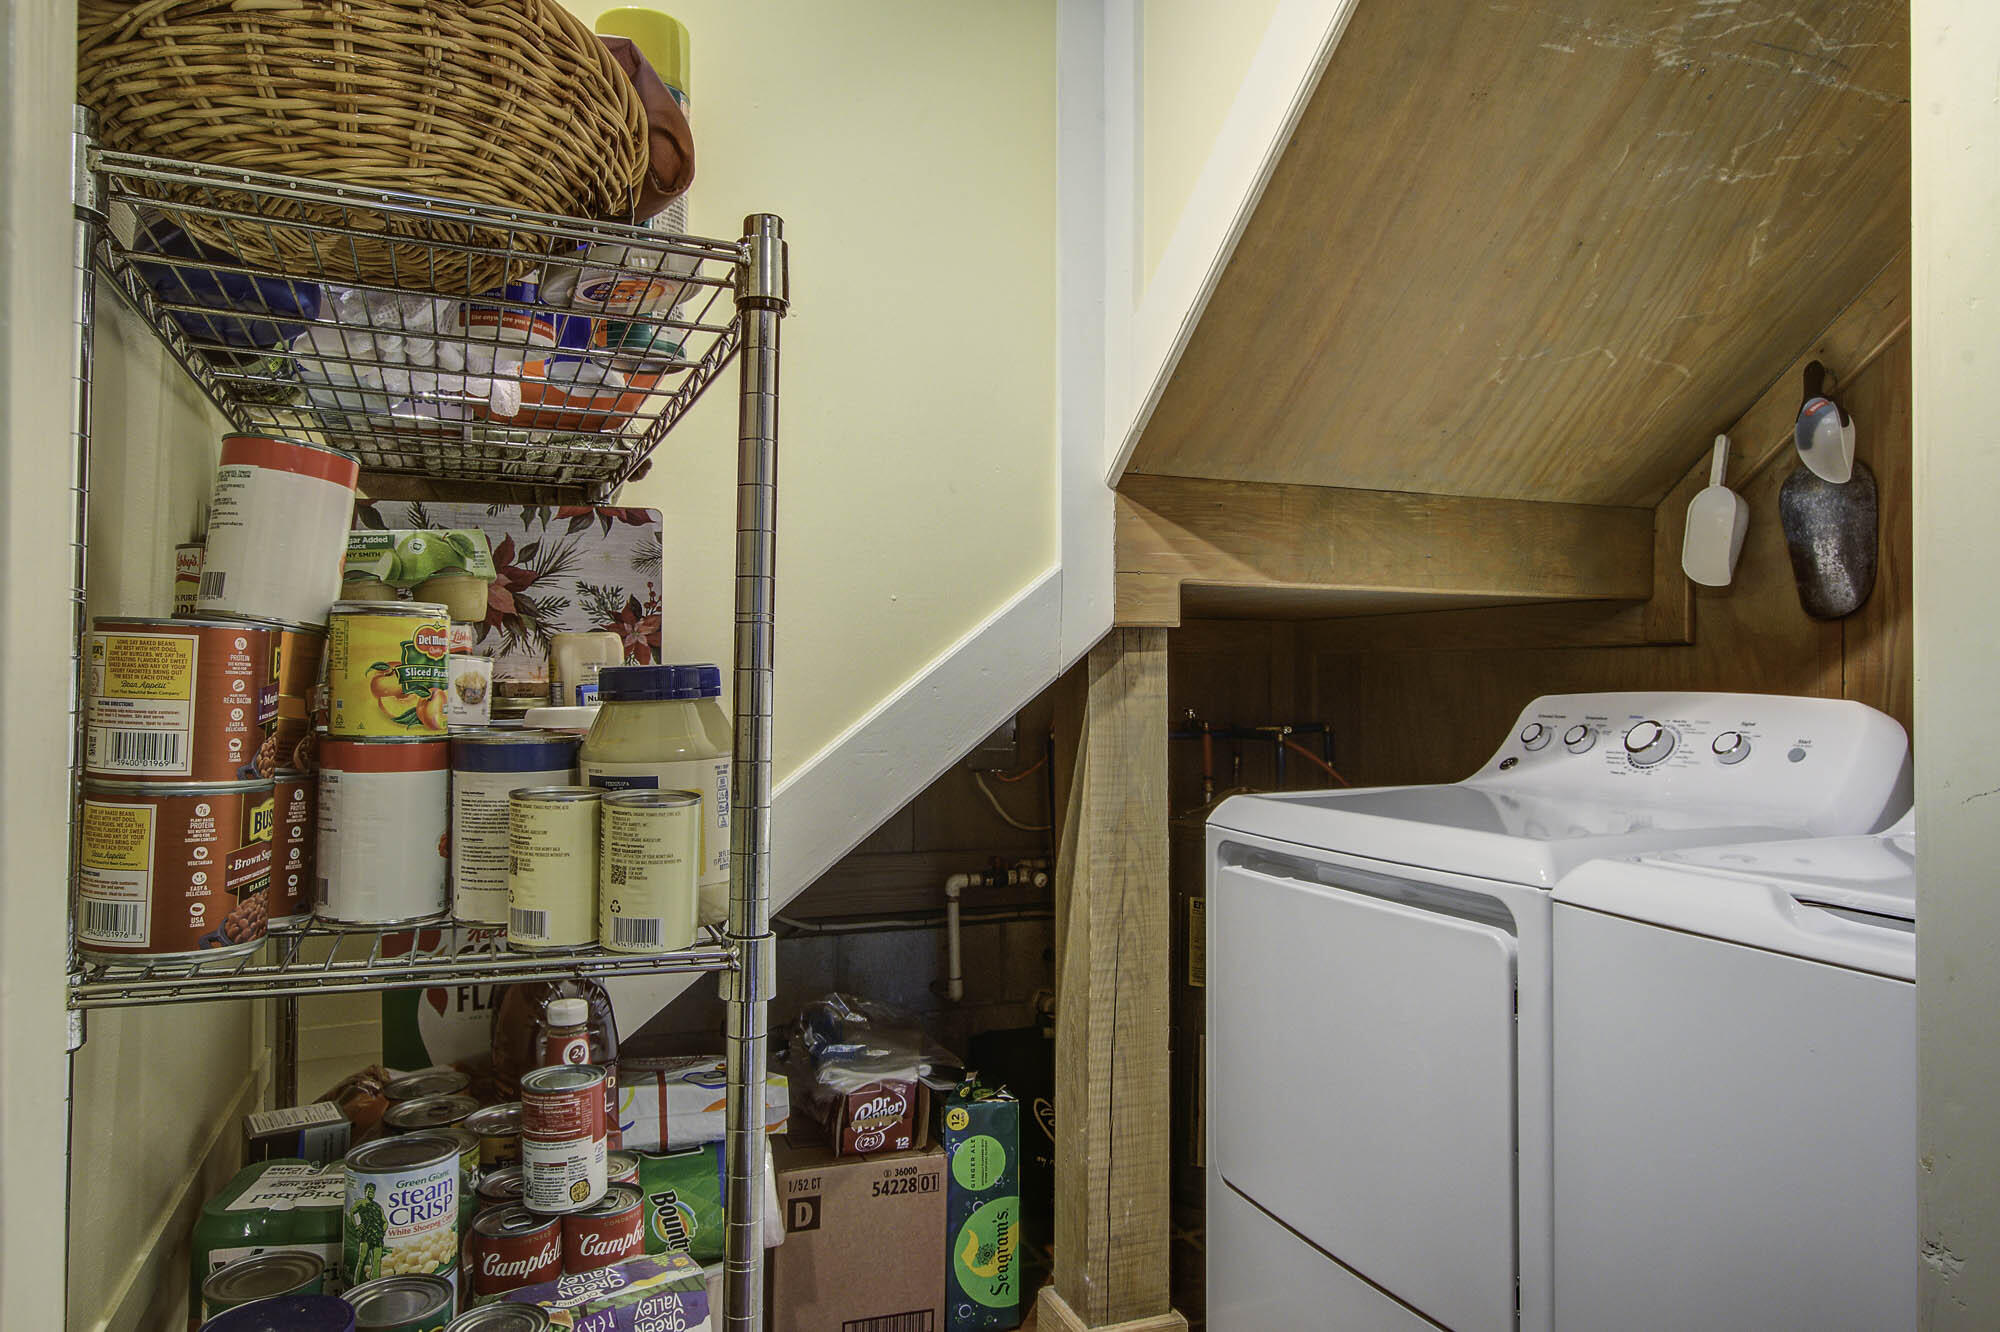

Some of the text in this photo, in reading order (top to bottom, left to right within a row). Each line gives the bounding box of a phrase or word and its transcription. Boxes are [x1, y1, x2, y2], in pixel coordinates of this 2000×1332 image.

[362, 536, 388, 544] Added
[418, 634, 431, 645] Del
[405, 667, 431, 677] Sliced
[190, 821, 215, 829] PROTEIN
[234, 855, 261, 871] Brown
[190, 916, 204, 924] USA
[571, 1048, 584, 1059] 24
[872, 1096, 891, 1111] Dr
[951, 1113, 960, 1127] 12
[895, 1136, 910, 1148] 12
[395, 1169, 450, 1189] Green Giant
[894, 1166, 918, 1177] 36000
[788, 1177, 822, 1193] 1/52 CT
[871, 1174, 938, 1197] 54228 01
[388, 1178, 453, 1209] steam
[389, 1194, 453, 1226] CRISP
[795, 1201, 813, 1228] D
[649, 1189, 692, 1252] Bount
[388, 1228, 412, 1237] White
[413, 1220, 441, 1233] Shoepeg
